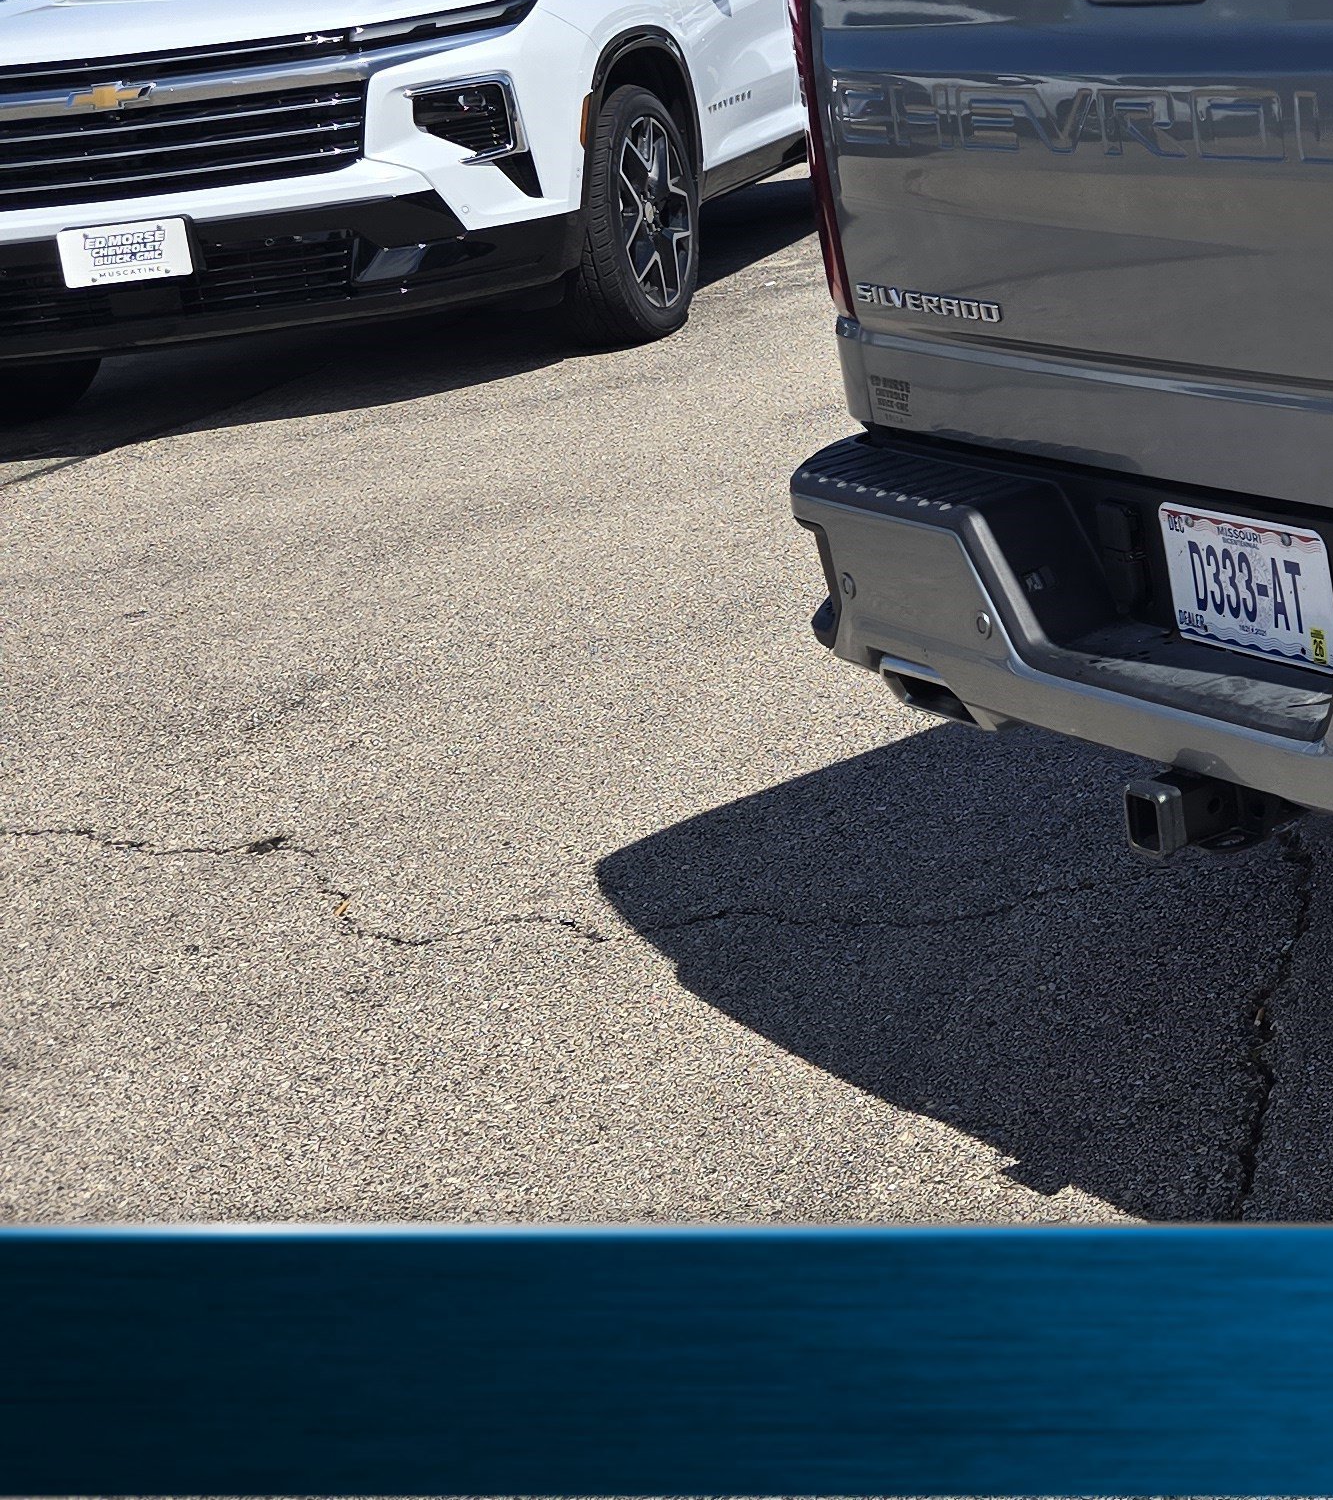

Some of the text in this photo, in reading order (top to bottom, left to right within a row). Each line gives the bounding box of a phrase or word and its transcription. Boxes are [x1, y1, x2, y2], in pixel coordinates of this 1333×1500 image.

[84, 230, 165, 250] ED MORSE
[91, 242, 161, 258] CHEVROLET
[99, 267, 162, 277] MUSCATINE
[856, 282, 1002, 323] SILVERADO
[1167, 514, 1185, 533] DEC
[1216, 526, 1262, 544] MISSOURI
[1188, 540, 1303, 634] D333-AT
[1178, 609, 1206, 628] DEALER
